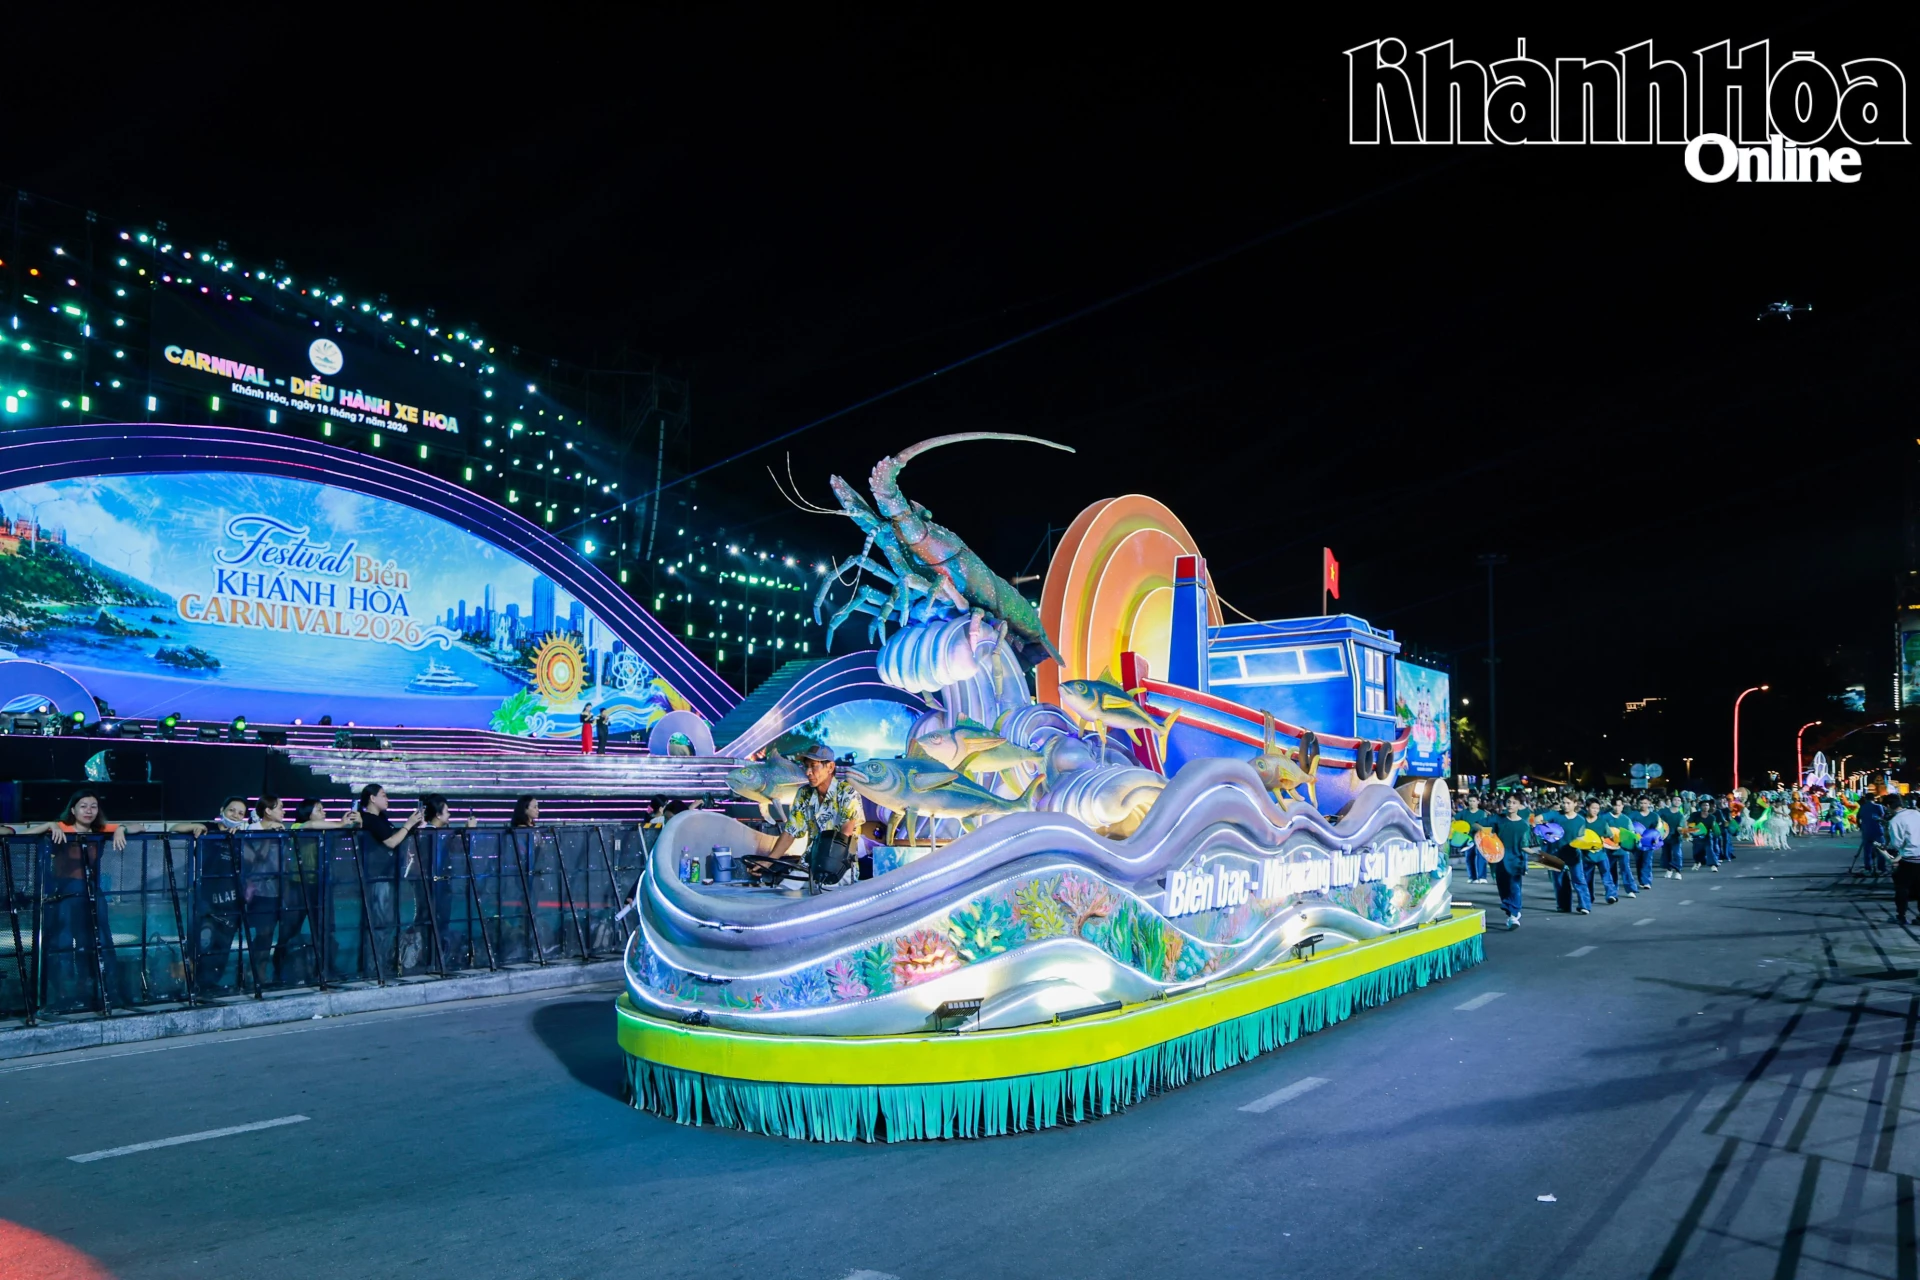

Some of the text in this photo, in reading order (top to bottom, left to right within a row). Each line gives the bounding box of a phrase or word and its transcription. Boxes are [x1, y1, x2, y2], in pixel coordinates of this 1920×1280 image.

[164, 345, 270, 387] CARNIVAL
[290, 375, 334, 402] DIỄU
[339, 387, 391, 416] HÀNH
[394, 402, 419, 424] XE
[422, 409, 459, 434] HOA
[231, 382, 409, 433] Khánh Hòa, ngày 18 tháng 7 năm 2026
[216, 516, 408, 589] Festival Biển
[179, 594, 423, 644] CARNIVAL 2026
[216, 568, 410, 617] KHÁNH HÒA
[1167, 854, 1214, 917] Biển
[1216, 863, 1251, 914] bạc
[1295, 851, 1331, 894] àng
[1332, 843, 1361, 888] thủy
[1363, 842, 1386, 882] sản
